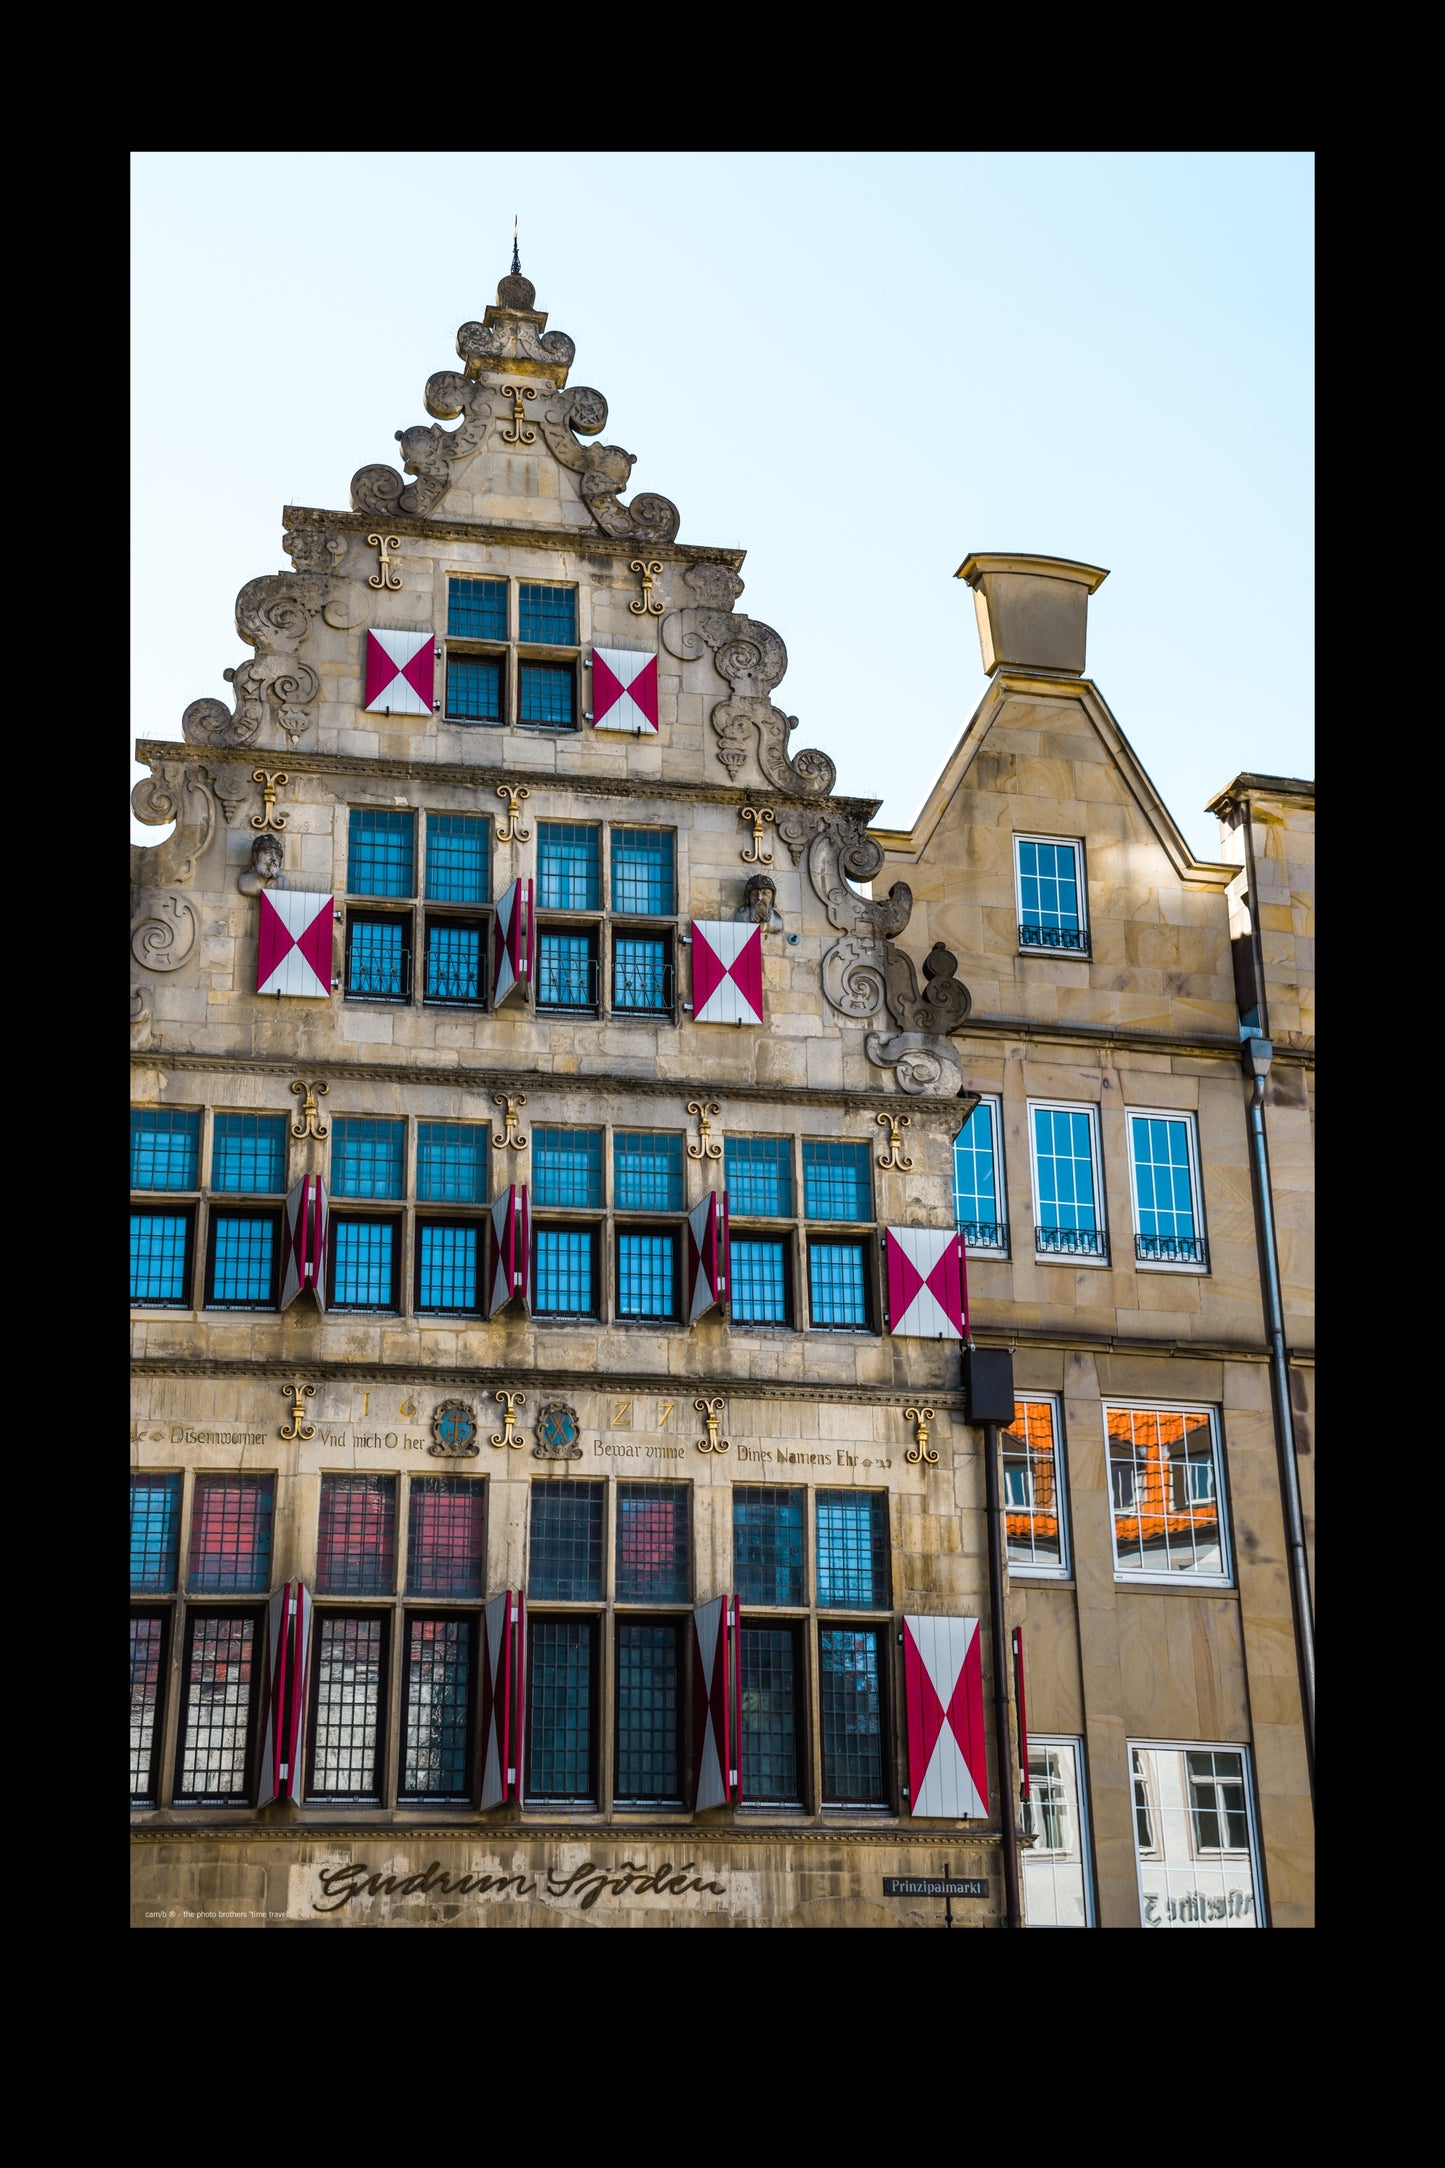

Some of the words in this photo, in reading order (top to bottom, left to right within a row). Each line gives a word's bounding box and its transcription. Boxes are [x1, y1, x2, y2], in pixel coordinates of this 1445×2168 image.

[353, 1432, 382, 1448] mich
[404, 1433, 426, 1450] her
[593, 1440, 642, 1457] Bewar
[737, 1445, 773, 1462] Dines
[776, 1447, 832, 1465] Namens
[312, 1861, 537, 1912] Gudrun
[891, 1879, 981, 1894] Prinzipalmarkt
